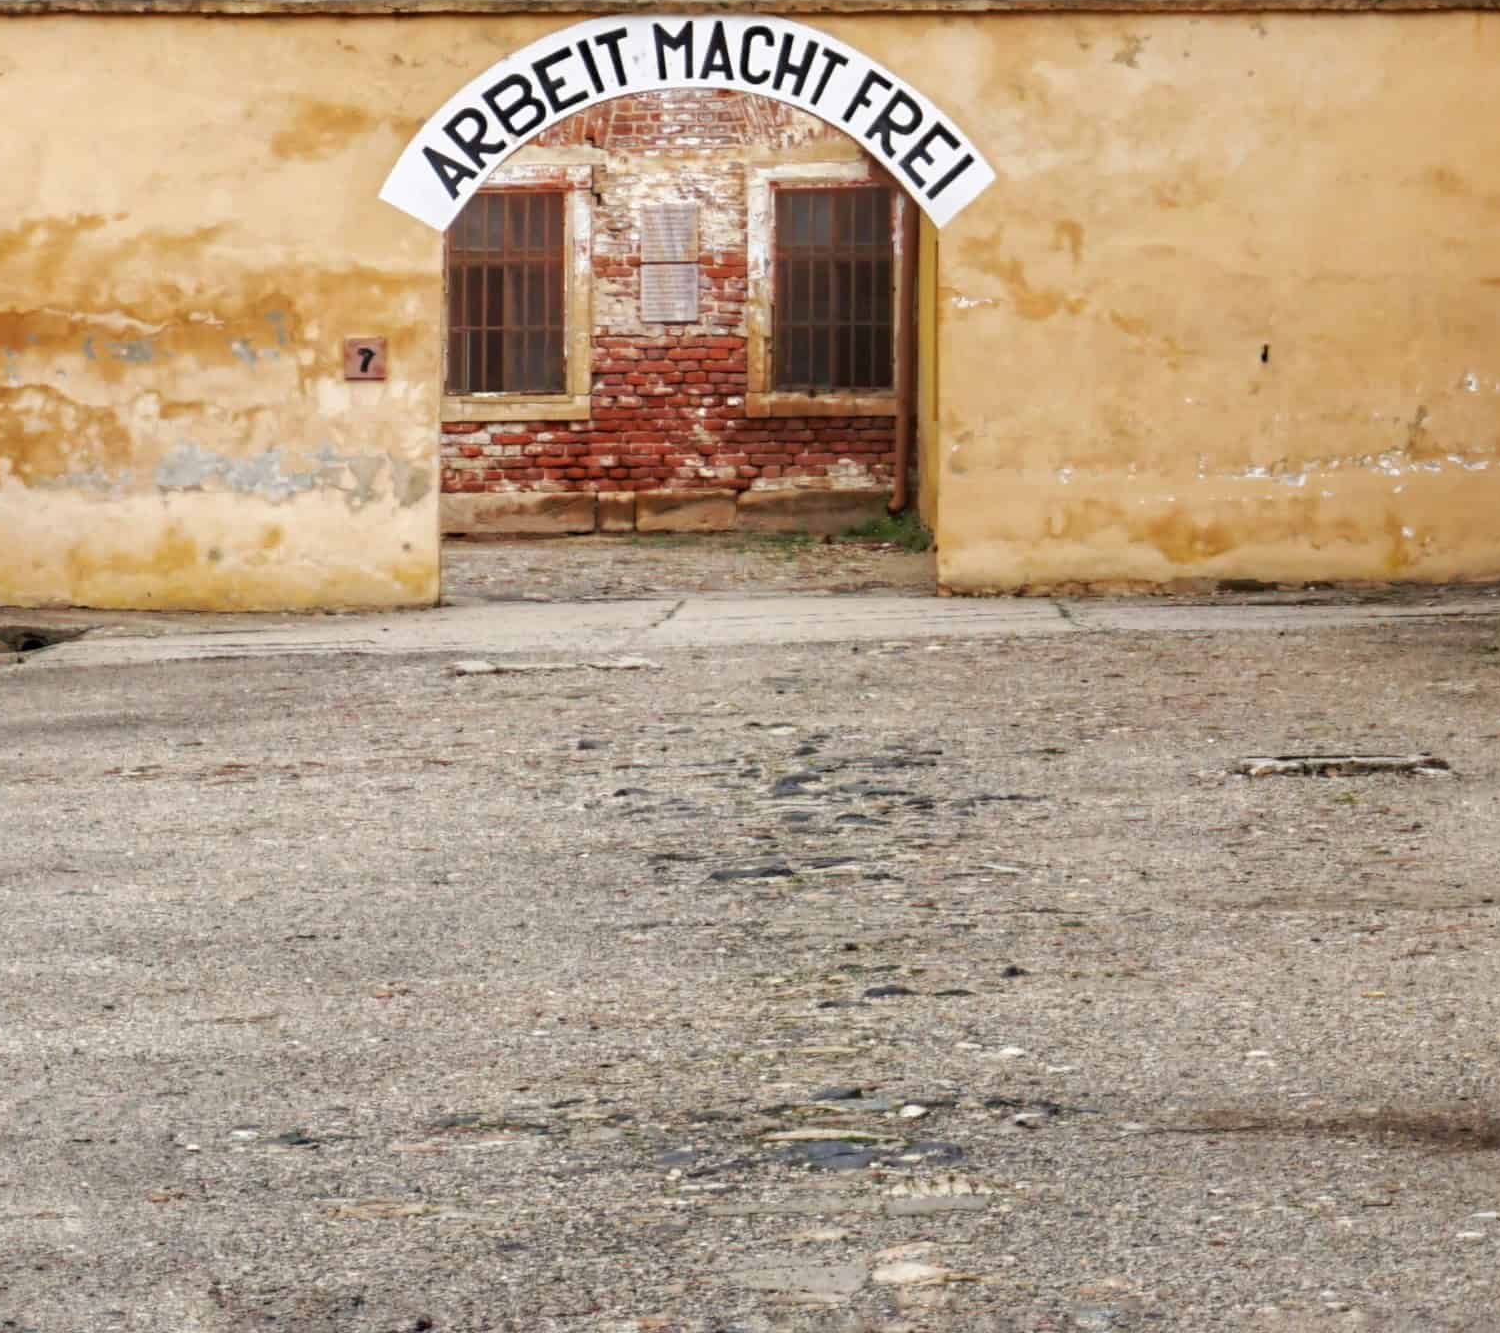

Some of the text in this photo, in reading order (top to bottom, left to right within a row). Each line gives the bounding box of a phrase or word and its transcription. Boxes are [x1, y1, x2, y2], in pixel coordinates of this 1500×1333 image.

[422, 19, 976, 201] ARBEIT MACHT FREI
[358, 347, 376, 374] 7
